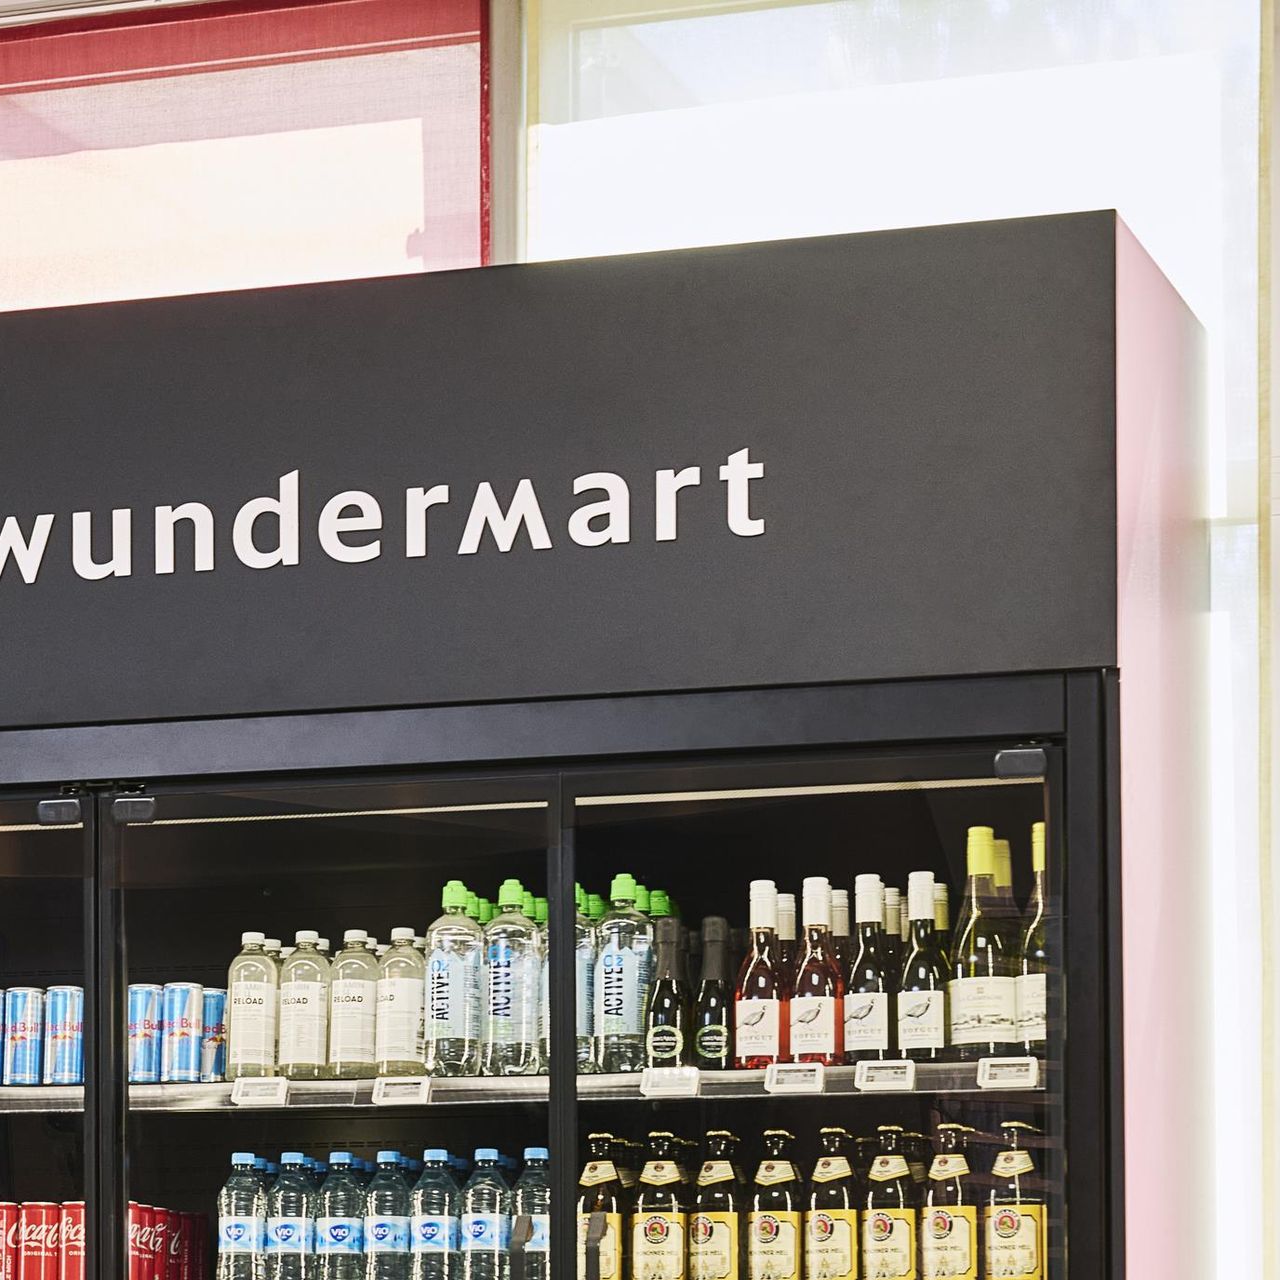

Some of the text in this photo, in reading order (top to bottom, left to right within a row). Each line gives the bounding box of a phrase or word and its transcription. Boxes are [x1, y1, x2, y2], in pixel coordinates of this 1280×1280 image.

[233, 996, 264, 1005] RELOAD
[333, 995, 364, 1004] RELOAD
[432, 971, 449, 1020] ACTIVE
[488, 961, 511, 1017] ACTIVE
[604, 967, 623, 1016] ACTIVE
